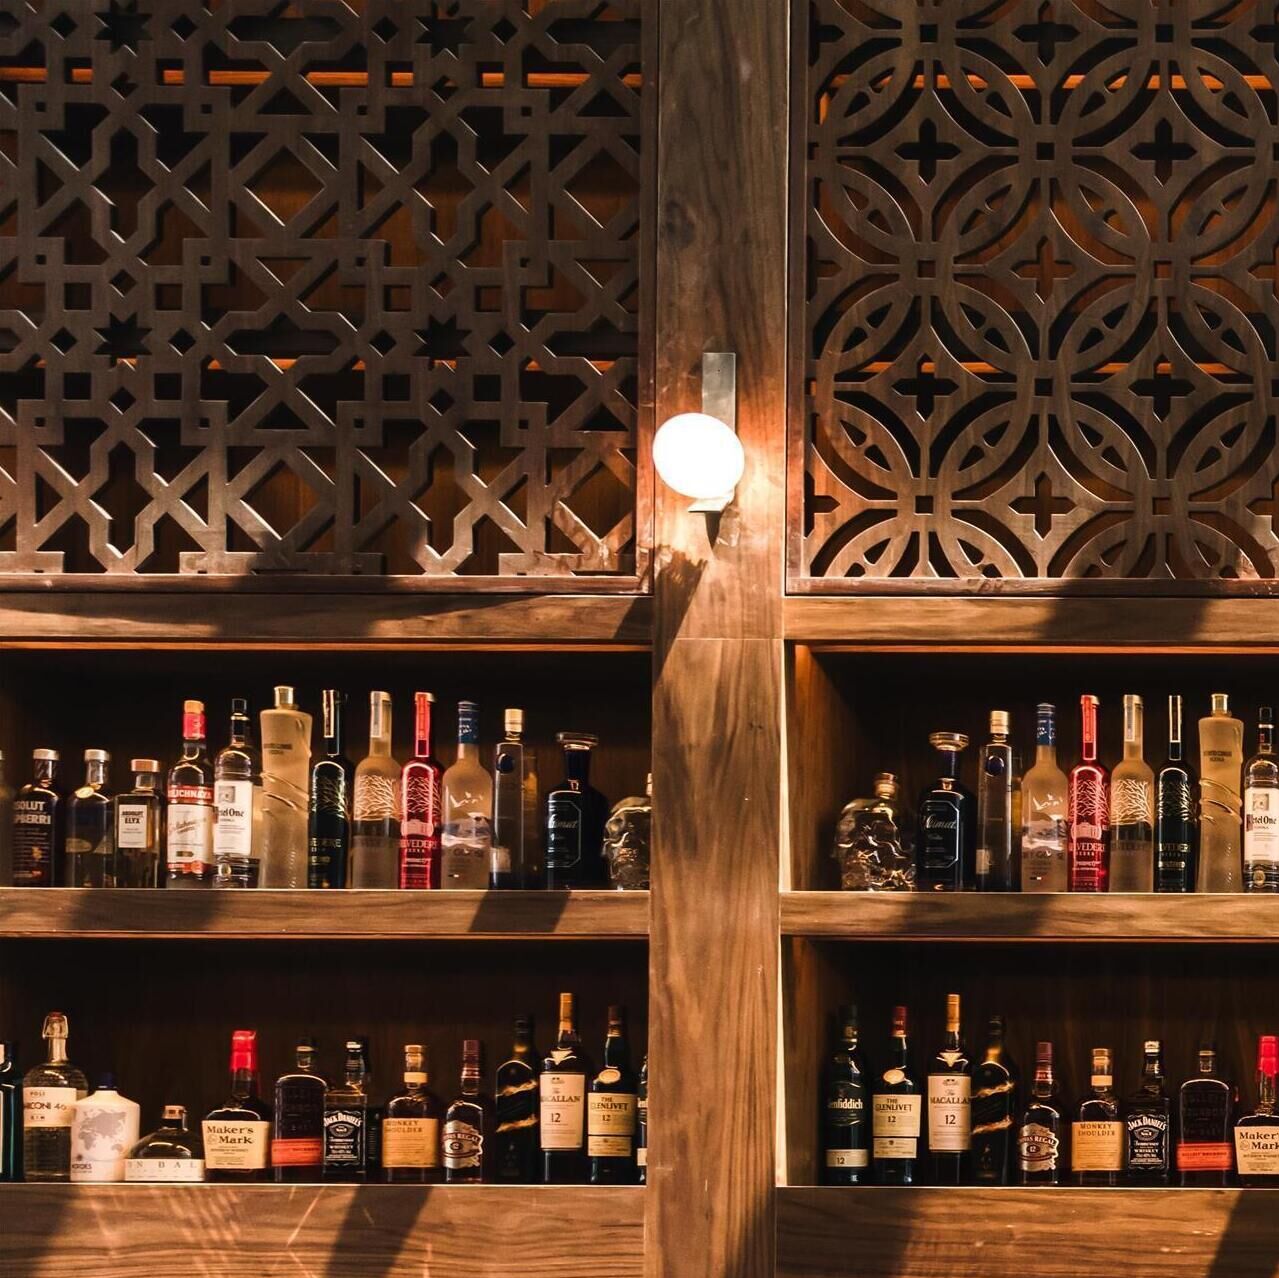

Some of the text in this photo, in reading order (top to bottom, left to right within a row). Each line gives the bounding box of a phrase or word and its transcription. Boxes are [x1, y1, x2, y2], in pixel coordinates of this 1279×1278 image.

[875, 1103, 912, 1111] GLENLIVET
[551, 1112, 562, 1123] 12
[887, 1115, 897, 1123] 12
[944, 1114, 956, 1125] 12
[206, 1125, 254, 1135] Maker's
[219, 1135, 254, 1145] Mark
[836, 1156, 846, 1165] 12
